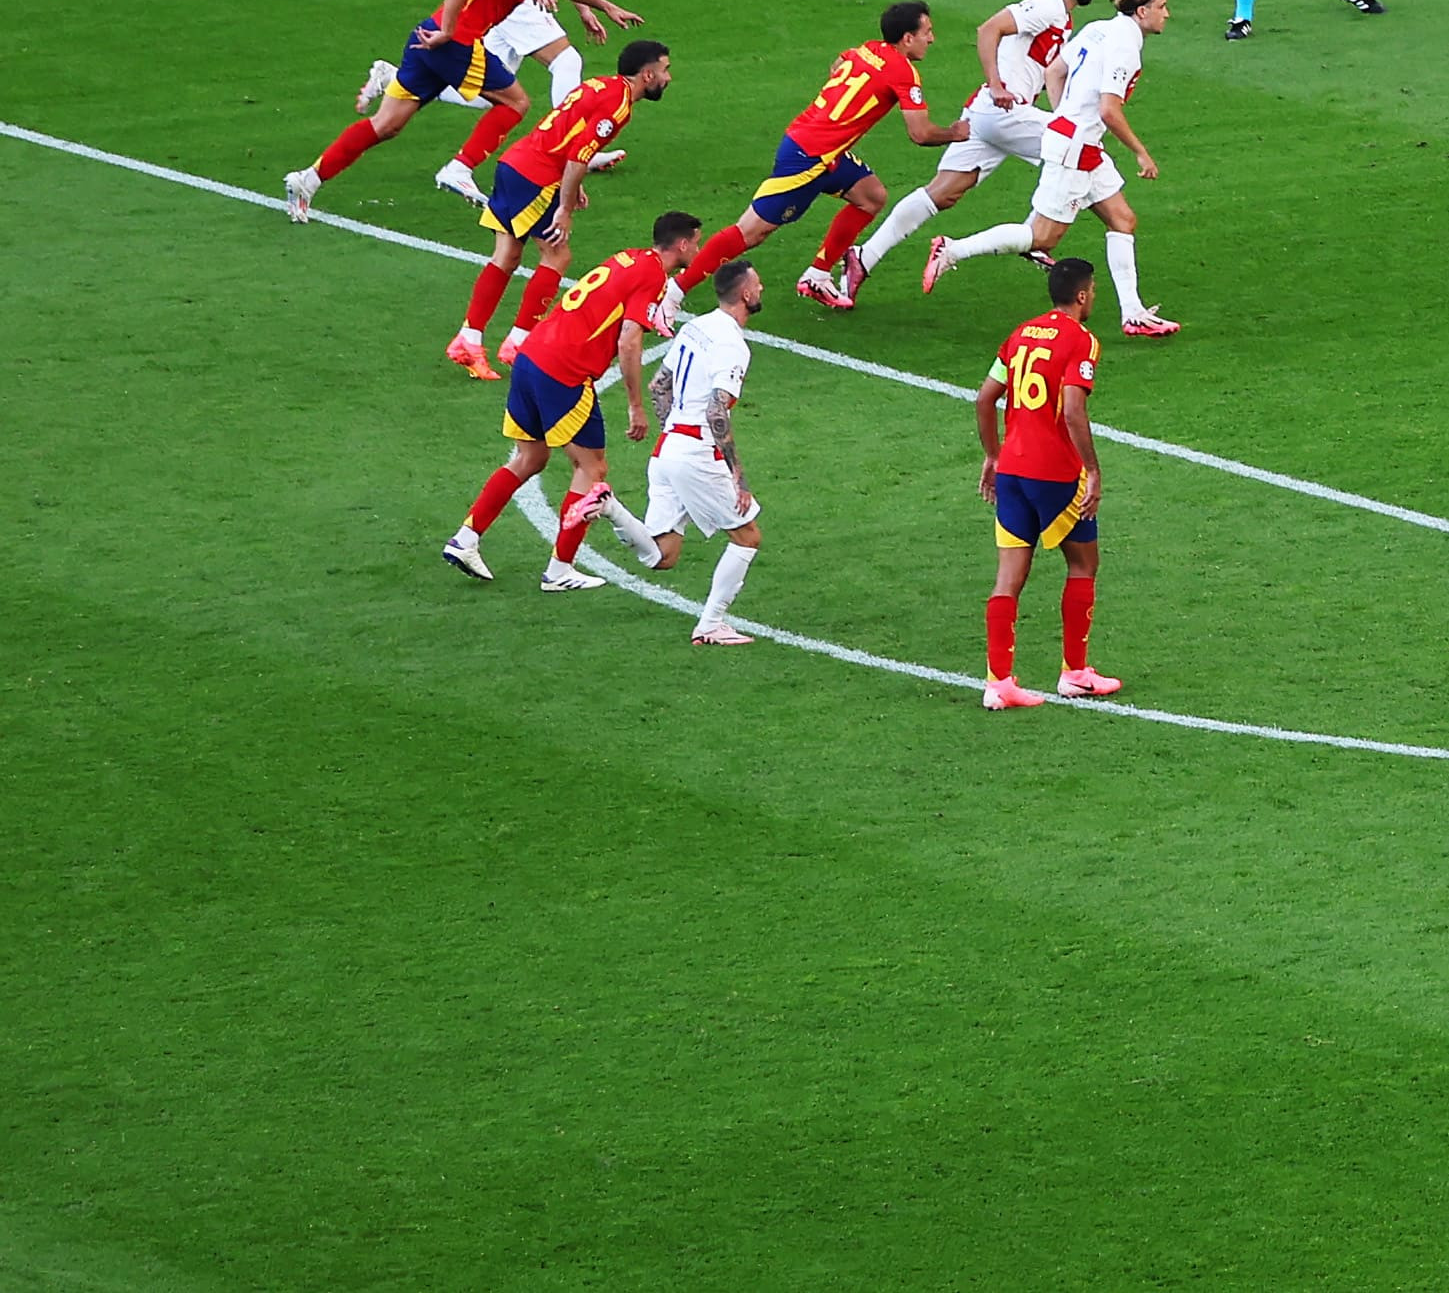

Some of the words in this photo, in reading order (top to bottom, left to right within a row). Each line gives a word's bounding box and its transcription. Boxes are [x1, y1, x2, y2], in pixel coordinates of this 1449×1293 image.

[815, 59, 872, 121] 21
[1065, 46, 1089, 92] 7
[561, 265, 611, 312] 8
[671, 344, 695, 410] 11
[1009, 344, 1051, 410] 16
